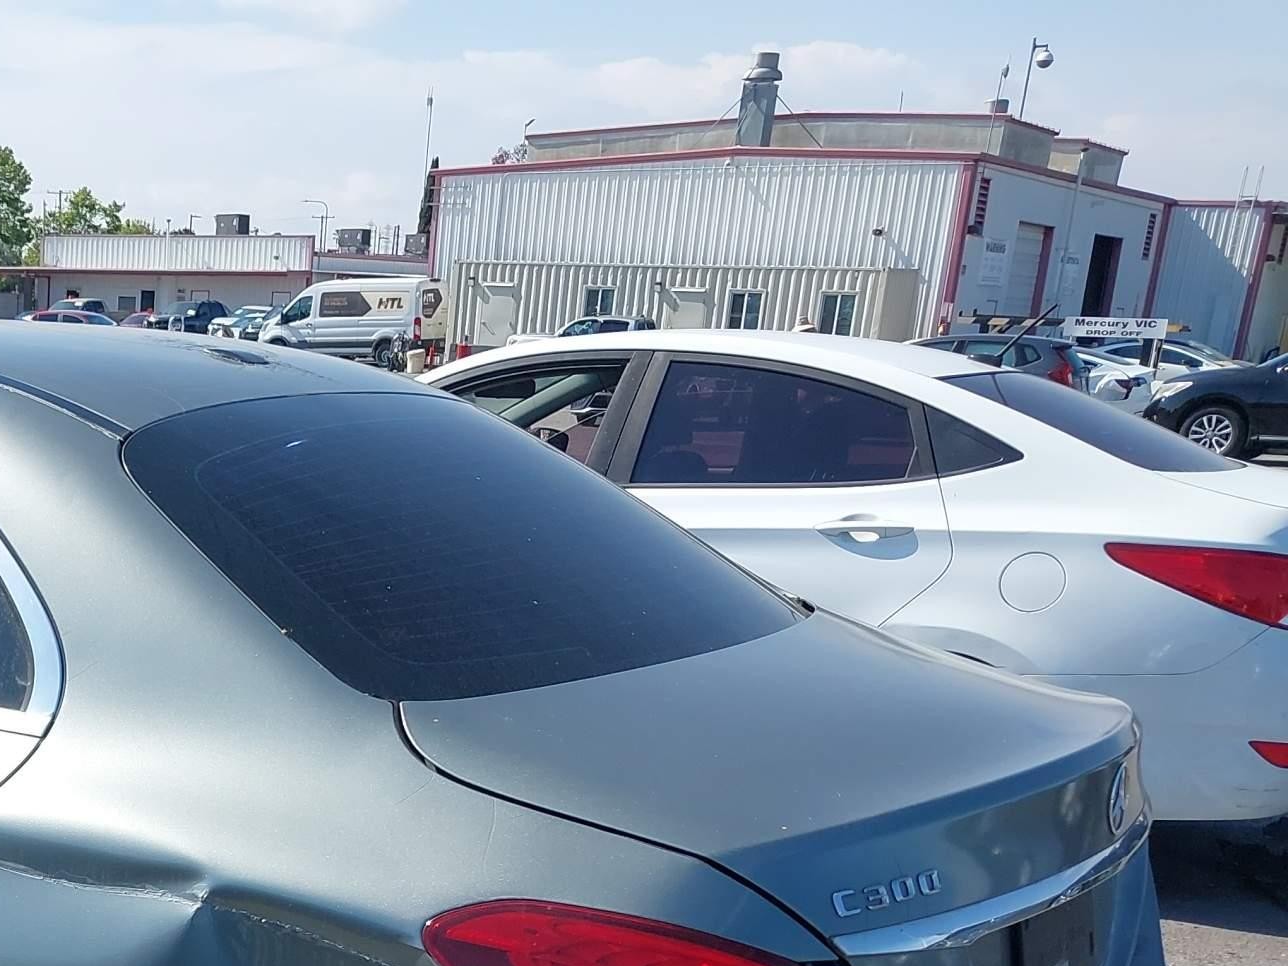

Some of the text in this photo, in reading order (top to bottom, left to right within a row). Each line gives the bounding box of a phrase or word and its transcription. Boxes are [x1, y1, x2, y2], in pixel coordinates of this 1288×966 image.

[1074, 318, 1158, 329] Mercury VIC
[831, 869, 942, 918] C300
